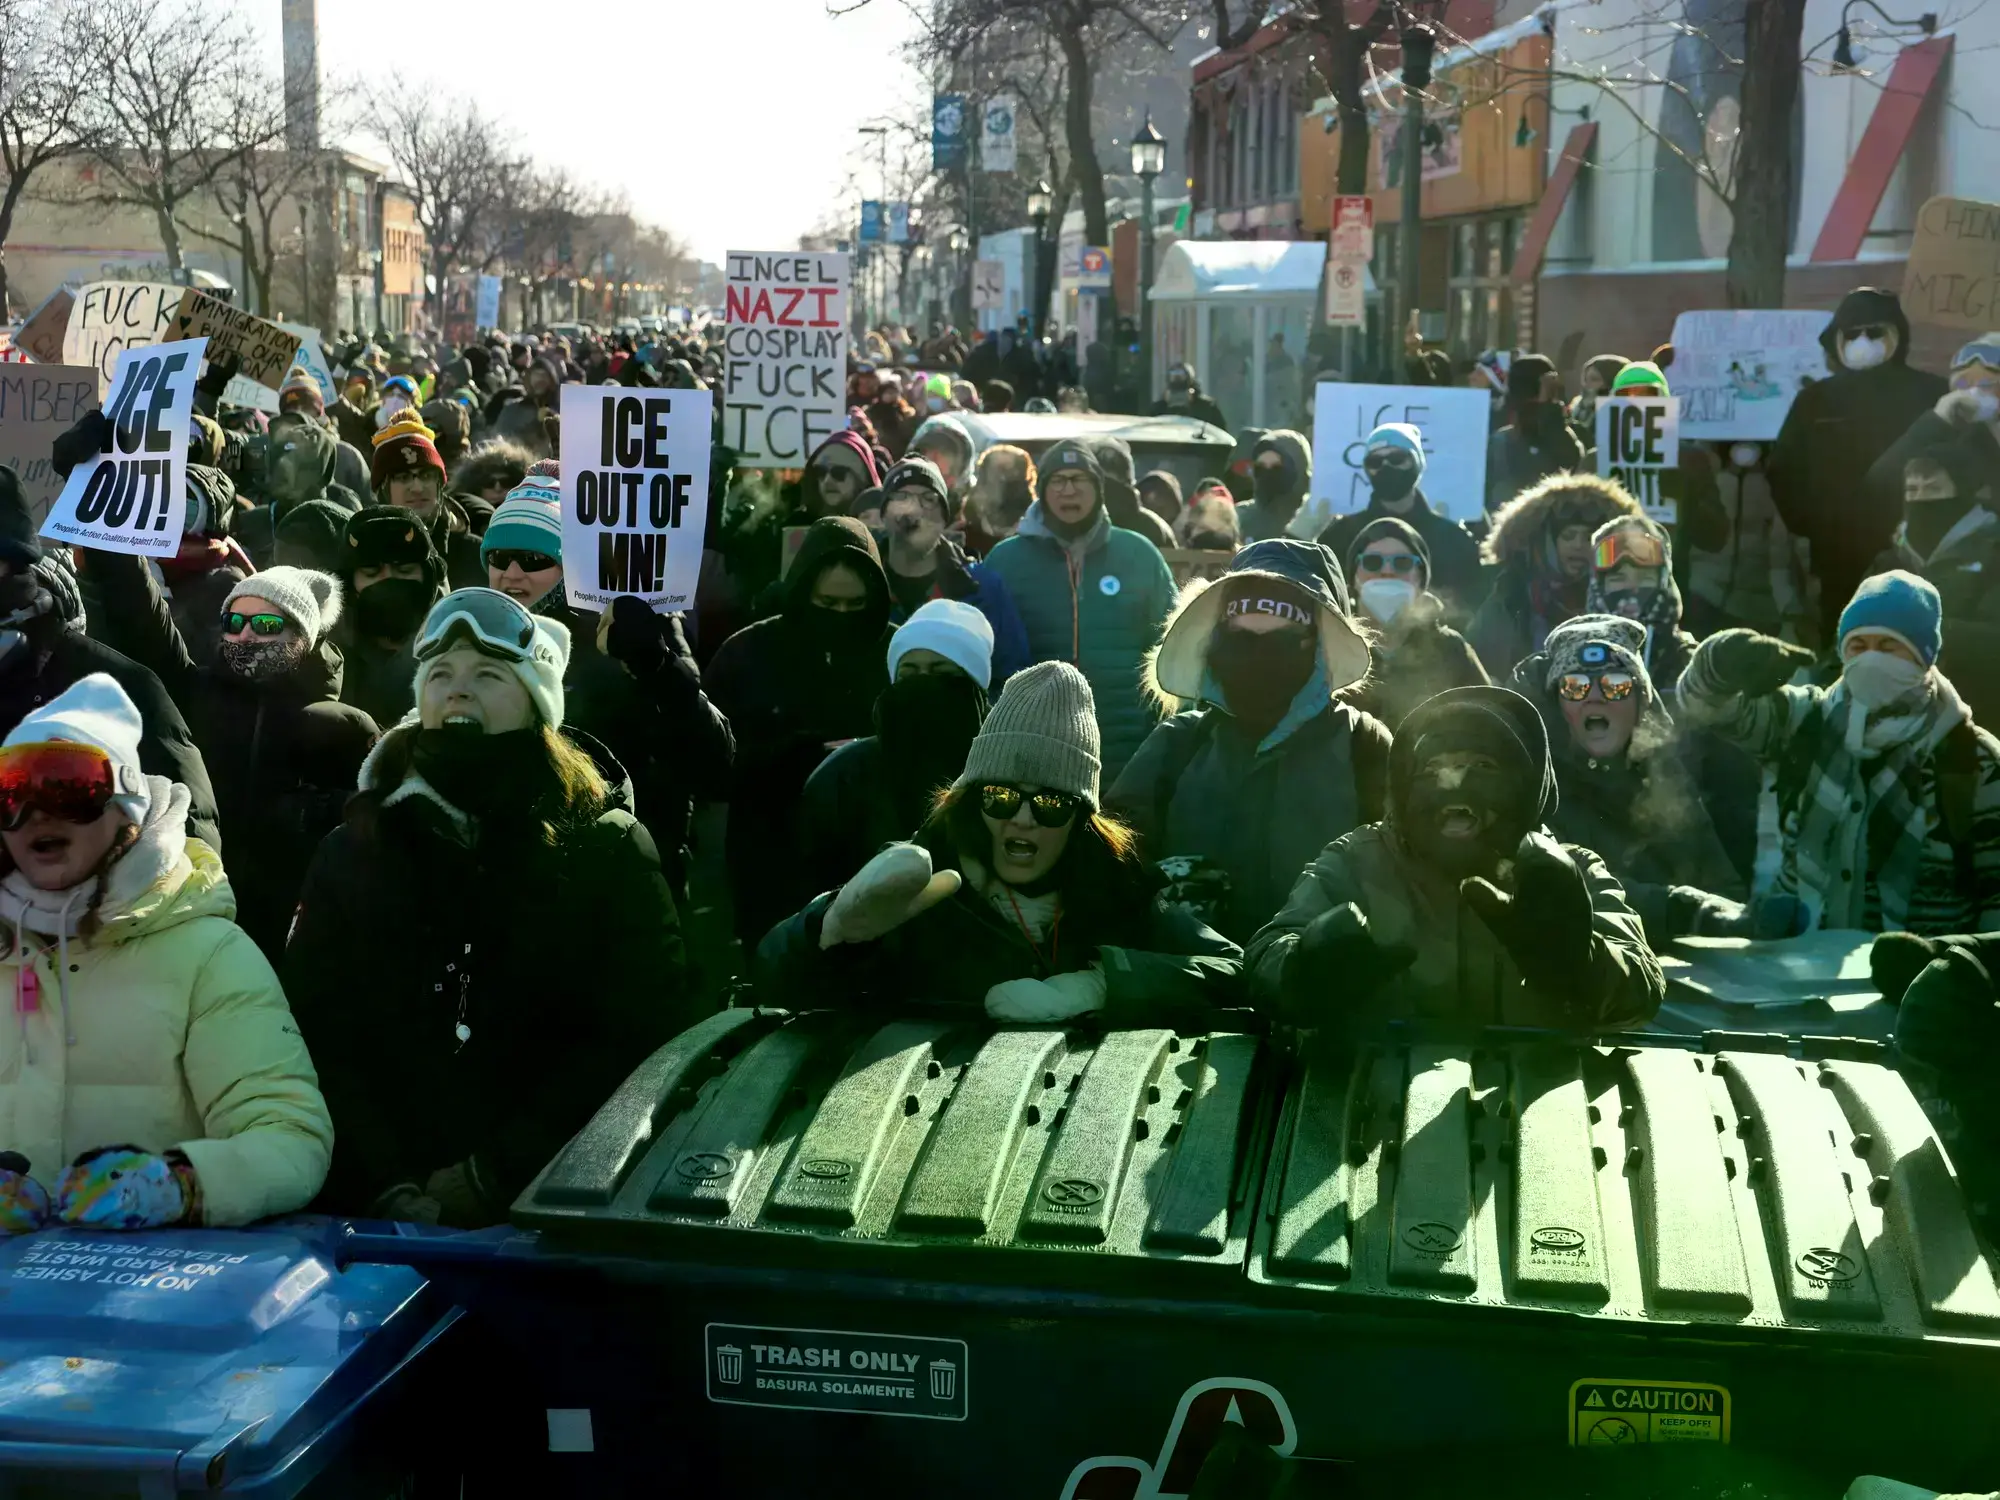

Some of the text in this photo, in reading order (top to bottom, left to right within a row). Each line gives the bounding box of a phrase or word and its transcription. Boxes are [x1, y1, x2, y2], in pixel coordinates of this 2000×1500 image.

[729, 255, 838, 283] INCEL
[82, 284, 180, 333] FUCK
[726, 284, 840, 328] NAZI
[190, 292, 302, 354] IMMIGRATION
[200, 321, 286, 372] BUILT OUR
[726, 327, 843, 359] COSPLAY
[728, 361, 837, 399] FUCK
[101, 352, 190, 455] ICE
[601, 396, 671, 469] ICE
[726, 403, 832, 460] ICE
[1609, 405, 1666, 465] ICE
[75, 459, 172, 532] OUT!
[576, 470, 692, 529] OUT OF
[52, 522, 172, 548] People's Action Coalition Against Trump
[599, 532, 667, 593] MN!
[574, 590, 598, 603] People's
[668, 594, 688, 605] Trump
[21, 1251, 226, 1277] NO YARD WASTE
[28, 1240, 249, 1265] PLEASE RECYCLE
[12, 1266, 200, 1292] NO HOT ASHES
[1808, 1279, 1825, 1290] NO
[1613, 1306, 1632, 1317] IN
[1751, 1316, 1791, 1328] THIS
[750, 1344, 921, 1374] TRASH ONLY
[755, 1378, 916, 1399] BASURA SOLAMENTE
[1611, 1388, 1714, 1412] CAUTION
[1659, 1417, 1686, 1427] KEEP
